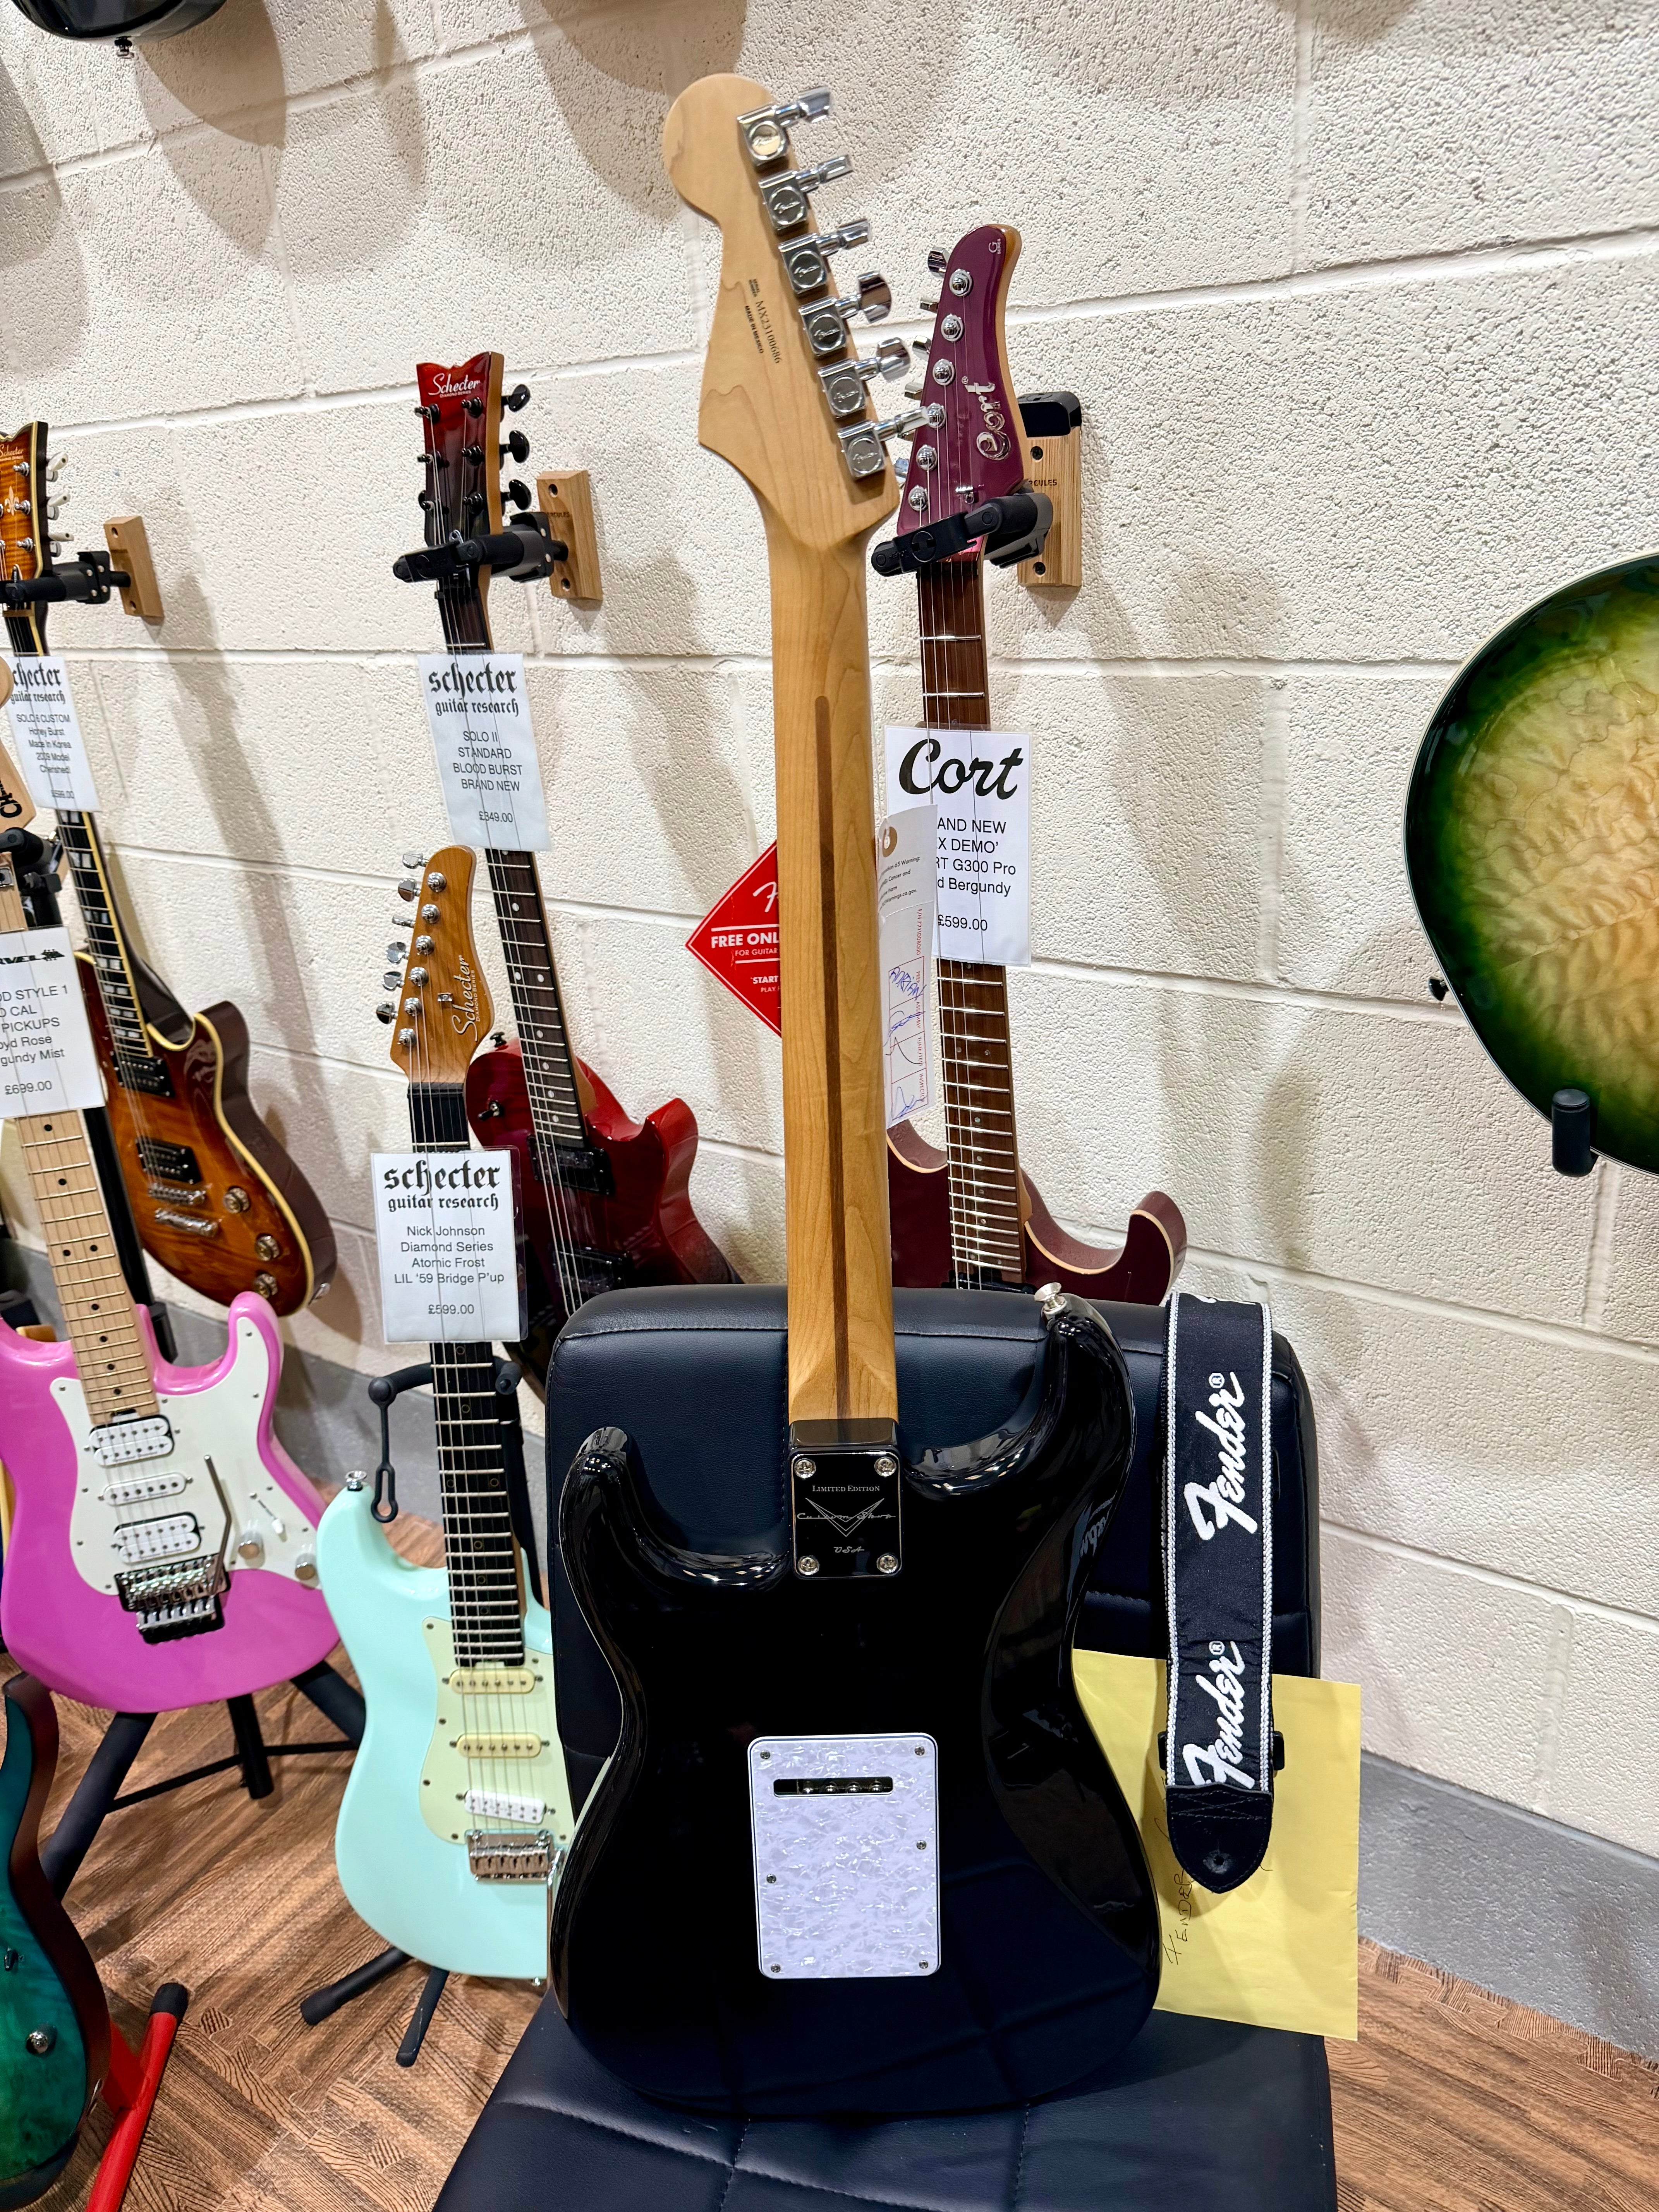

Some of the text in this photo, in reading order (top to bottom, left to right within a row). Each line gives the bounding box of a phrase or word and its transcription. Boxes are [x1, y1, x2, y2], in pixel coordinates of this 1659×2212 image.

[745, 306, 754, 323] MADE
[428, 373, 480, 395] Schecter
[12, 663, 62, 692] checter
[429, 662, 517, 699] schecter
[435, 698, 519, 716] guitar research
[463, 731, 489, 742] SOLO
[458, 747, 512, 759] STANDARD
[453, 763, 522, 775] BLOOD BURST
[899, 738, 1024, 800] Cort
[461, 779, 520, 791] BRAND NEW
[937, 817, 1006, 834] AND NEW
[953, 859, 988, 873] G300
[993, 861, 1016, 875] Pro
[949, 877, 1011, 896] Bergundy
[938, 914, 988, 931] £599.00
[711, 931, 780, 948] FREE ONL
[15, 986, 58, 1000] STYLE
[62, 985, 68, 994] 1
[452, 955, 477, 1042] Schecter
[10, 1005, 38, 1016] CAL
[1, 1017, 60, 1033] PICKUPS
[0, 1036, 52, 1051] oyd Rose
[0, 1048, 65, 1067] gundy Mist
[5, 1080, 53, 1096] £699.00
[384, 1159, 500, 1196] schecter
[388, 1193, 499, 1212] guitar research
[407, 1226, 485, 1236] Nick Johnson
[401, 1242, 494, 1252] Diamond Series
[412, 1257, 485, 1268] Atomic Frost
[395, 1274, 413, 1283] LIL
[438, 1273, 474, 1285] Bridge
[428, 1304, 474, 1315] £599.00
